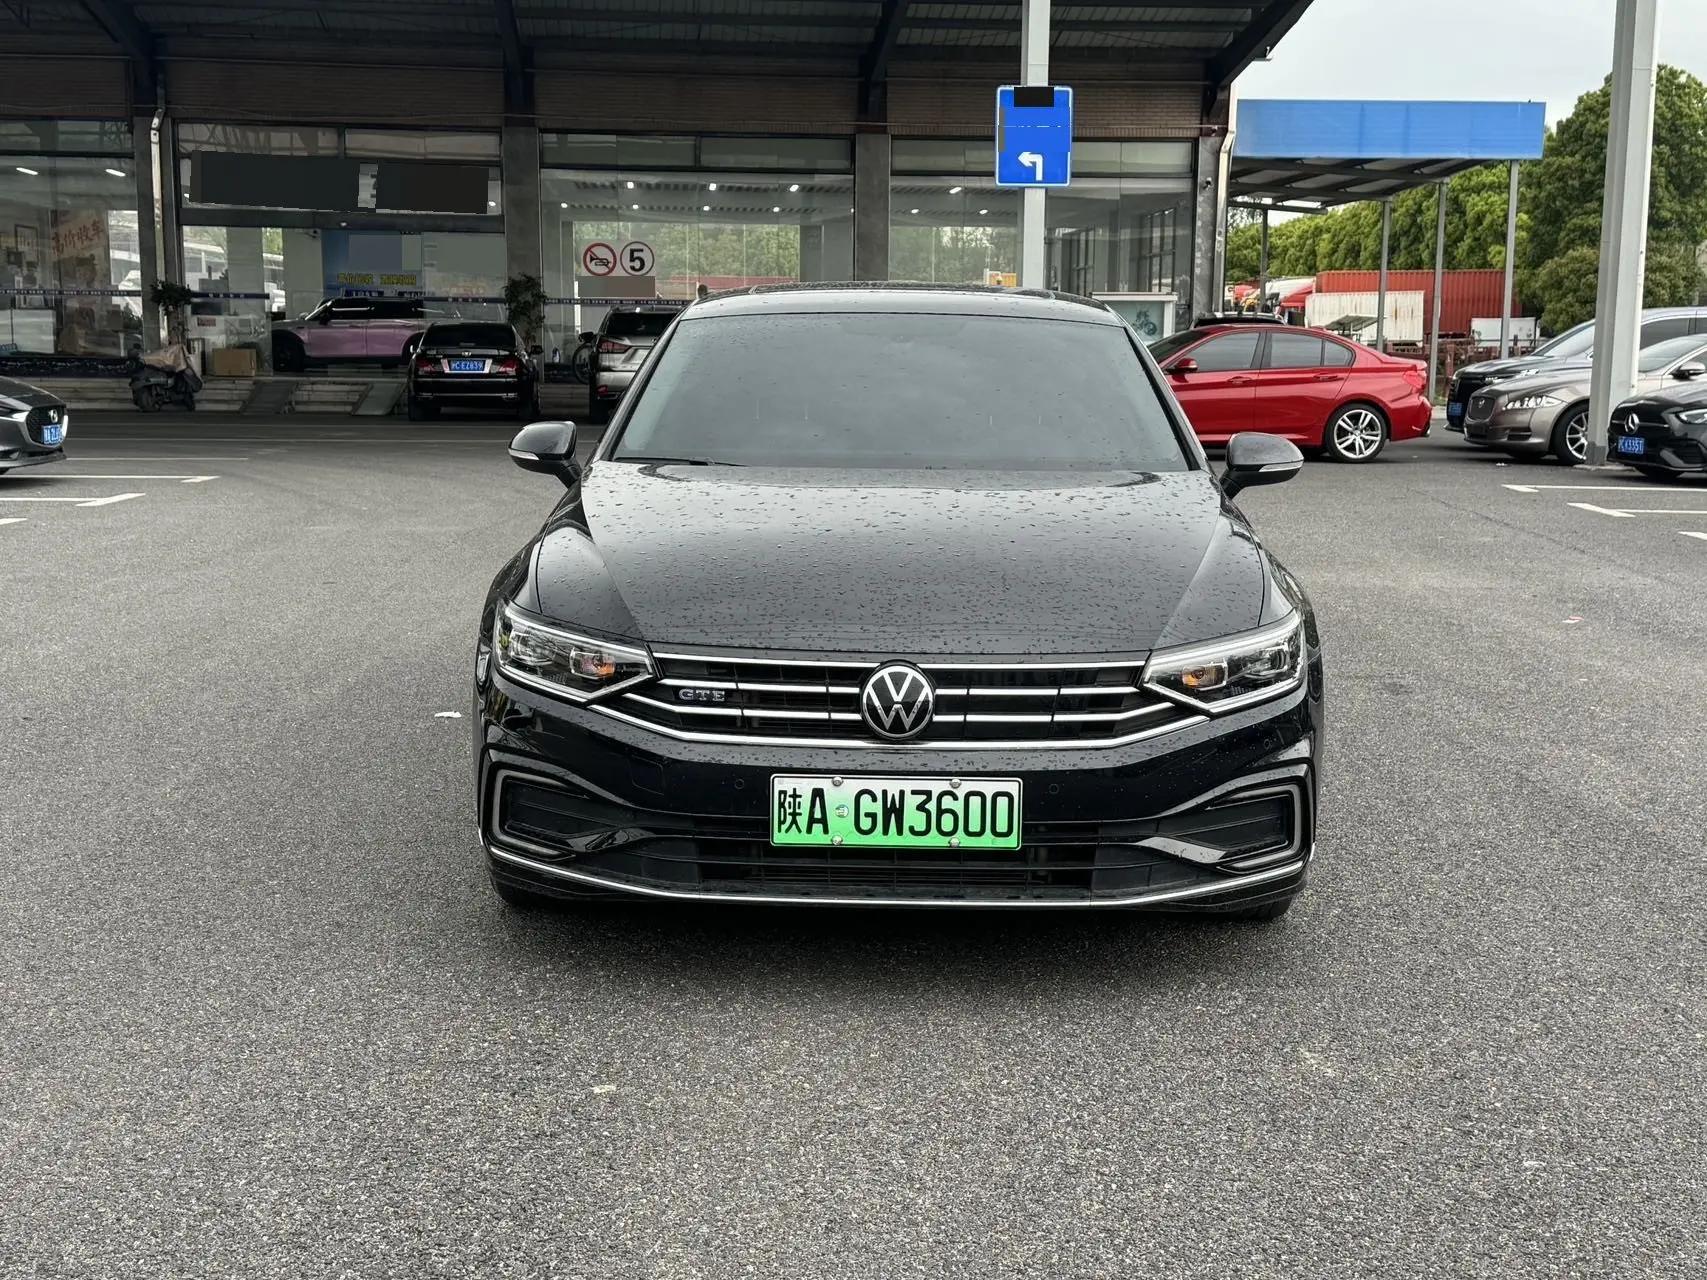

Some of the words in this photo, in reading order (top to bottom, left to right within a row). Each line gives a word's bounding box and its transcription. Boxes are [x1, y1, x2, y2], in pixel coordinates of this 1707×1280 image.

[629, 248, 645, 272] 5
[679, 689, 725, 701] GTE
[777, 788, 829, 834] 陕A
[854, 789, 1014, 837] GW3600
